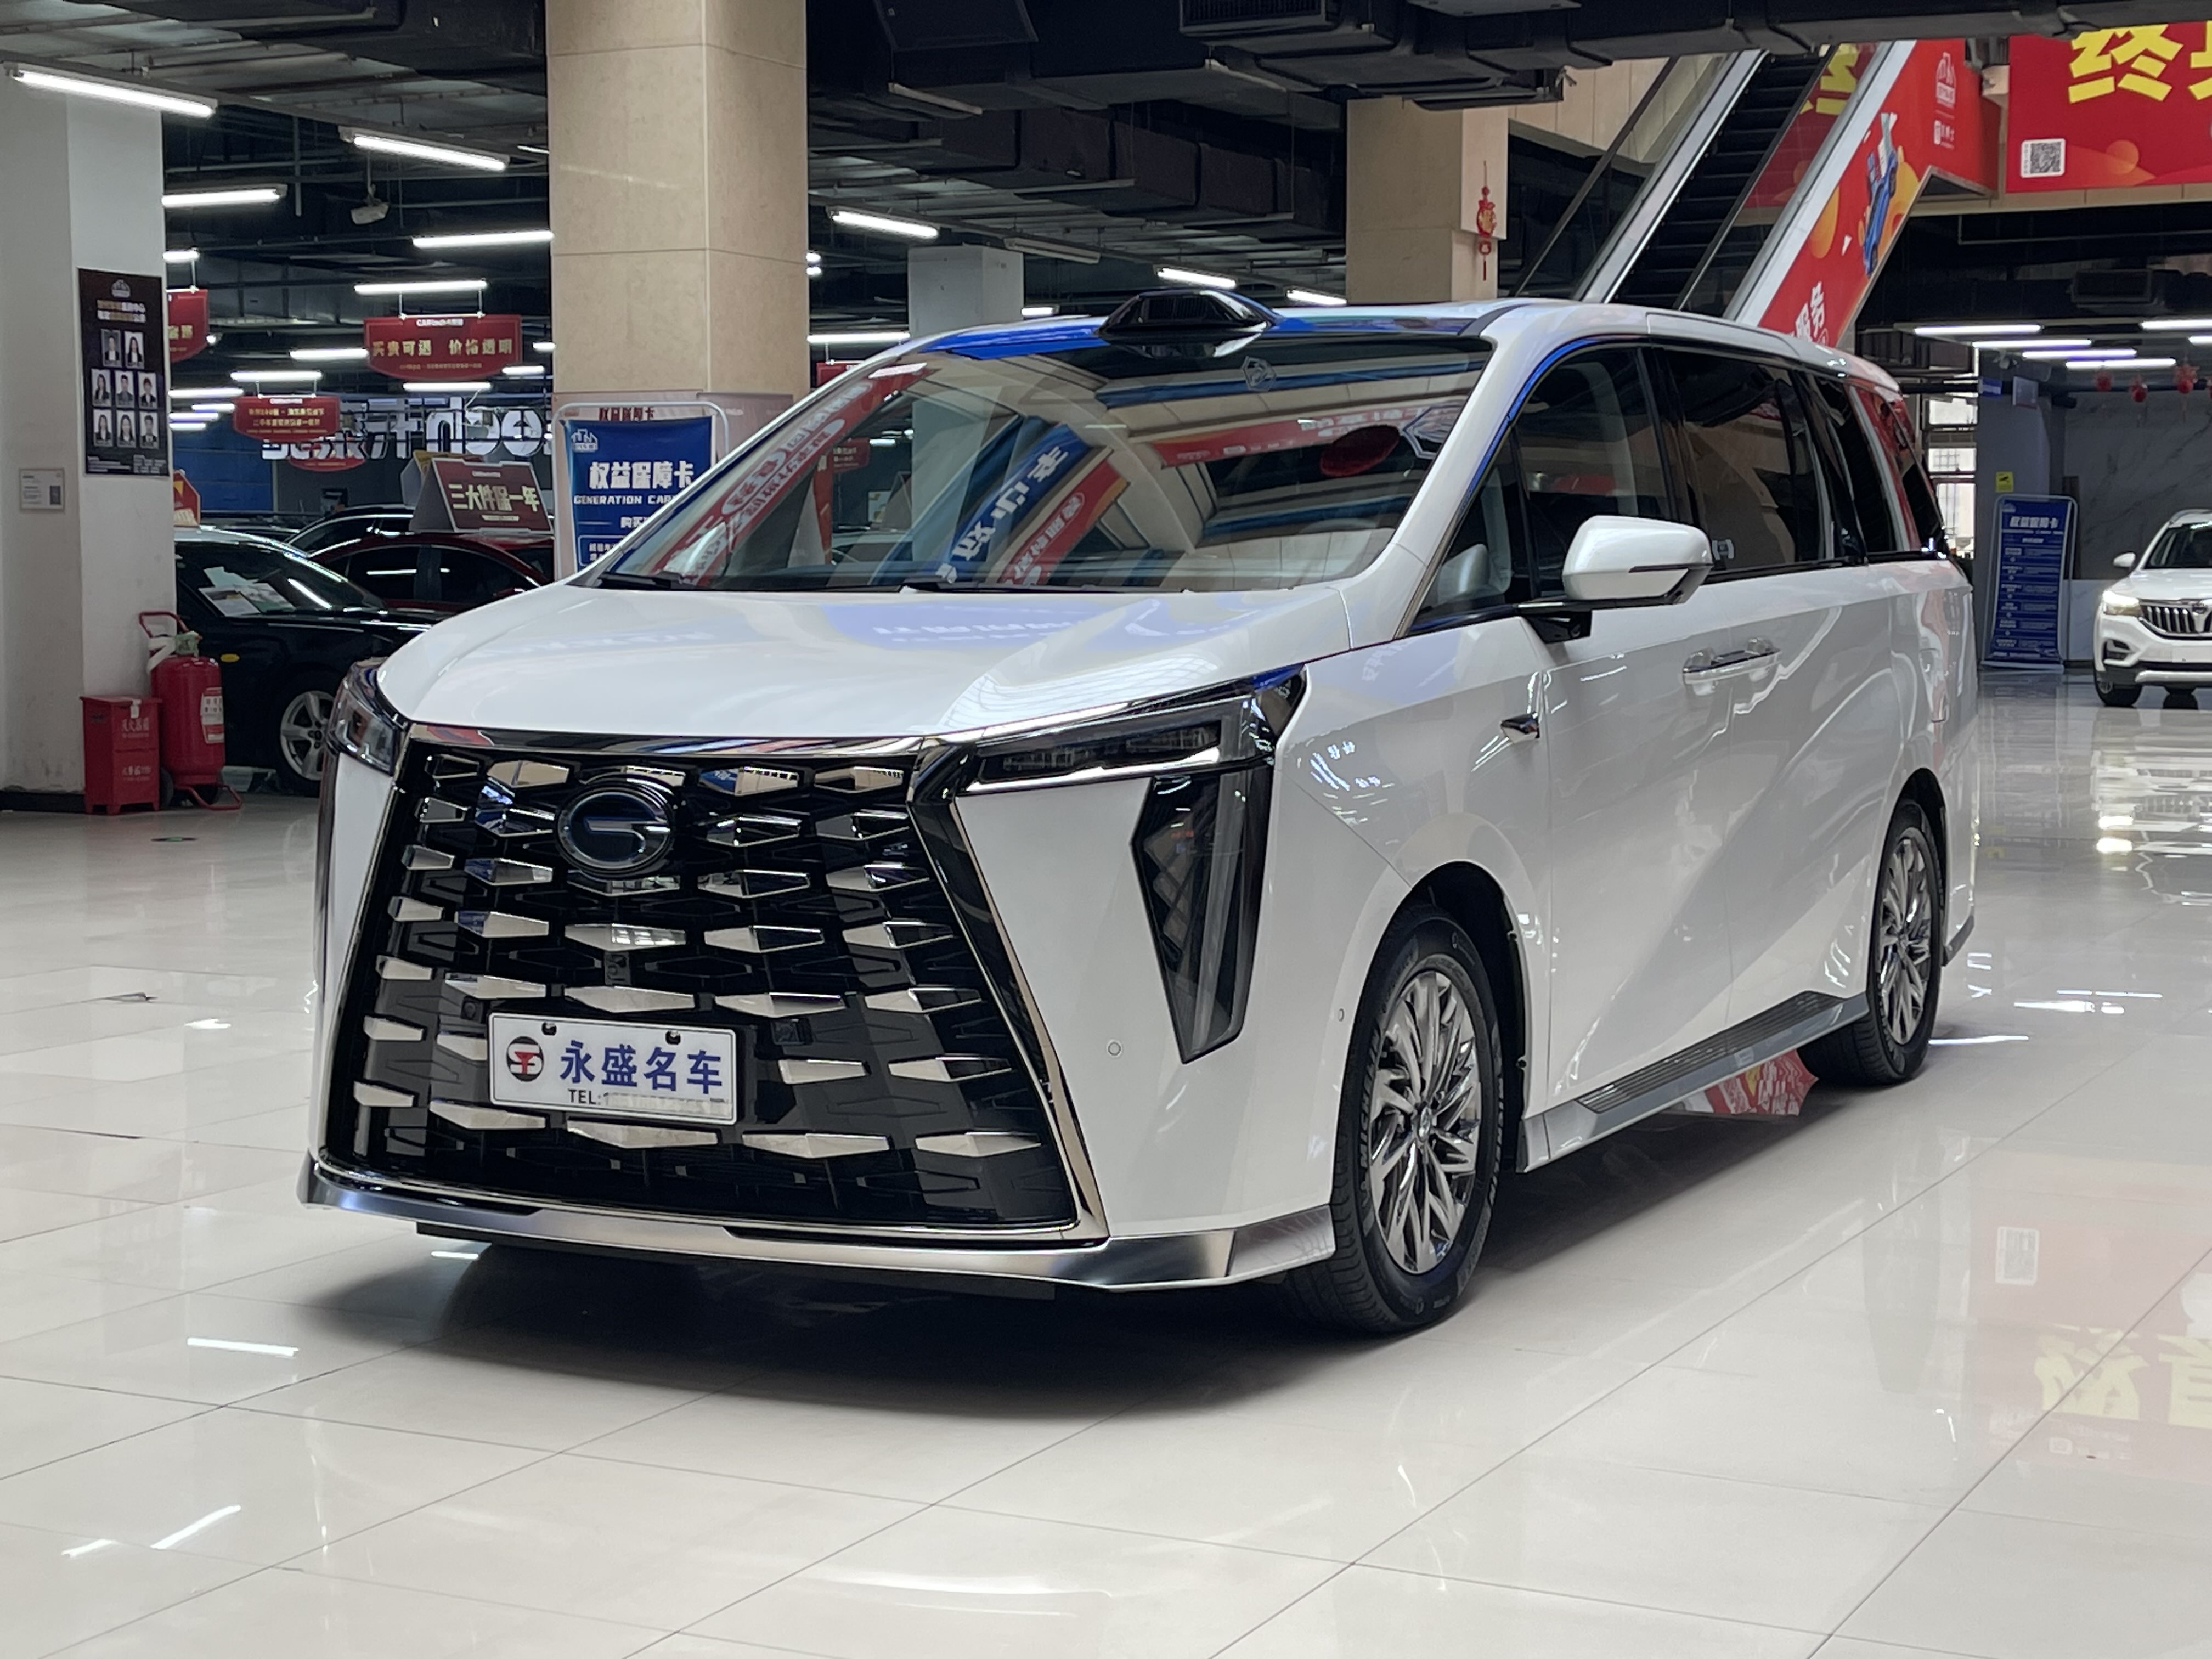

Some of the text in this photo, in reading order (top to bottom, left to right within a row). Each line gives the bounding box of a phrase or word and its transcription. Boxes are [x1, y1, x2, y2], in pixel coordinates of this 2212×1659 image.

[2068, 20, 2212, 103] 终
[449, 338, 512, 356] 价格透明
[589, 461, 695, 490] 权益保障卡
[574, 495, 676, 505] GENERATION CAR
[560, 1040, 723, 1094] 永盛名车
